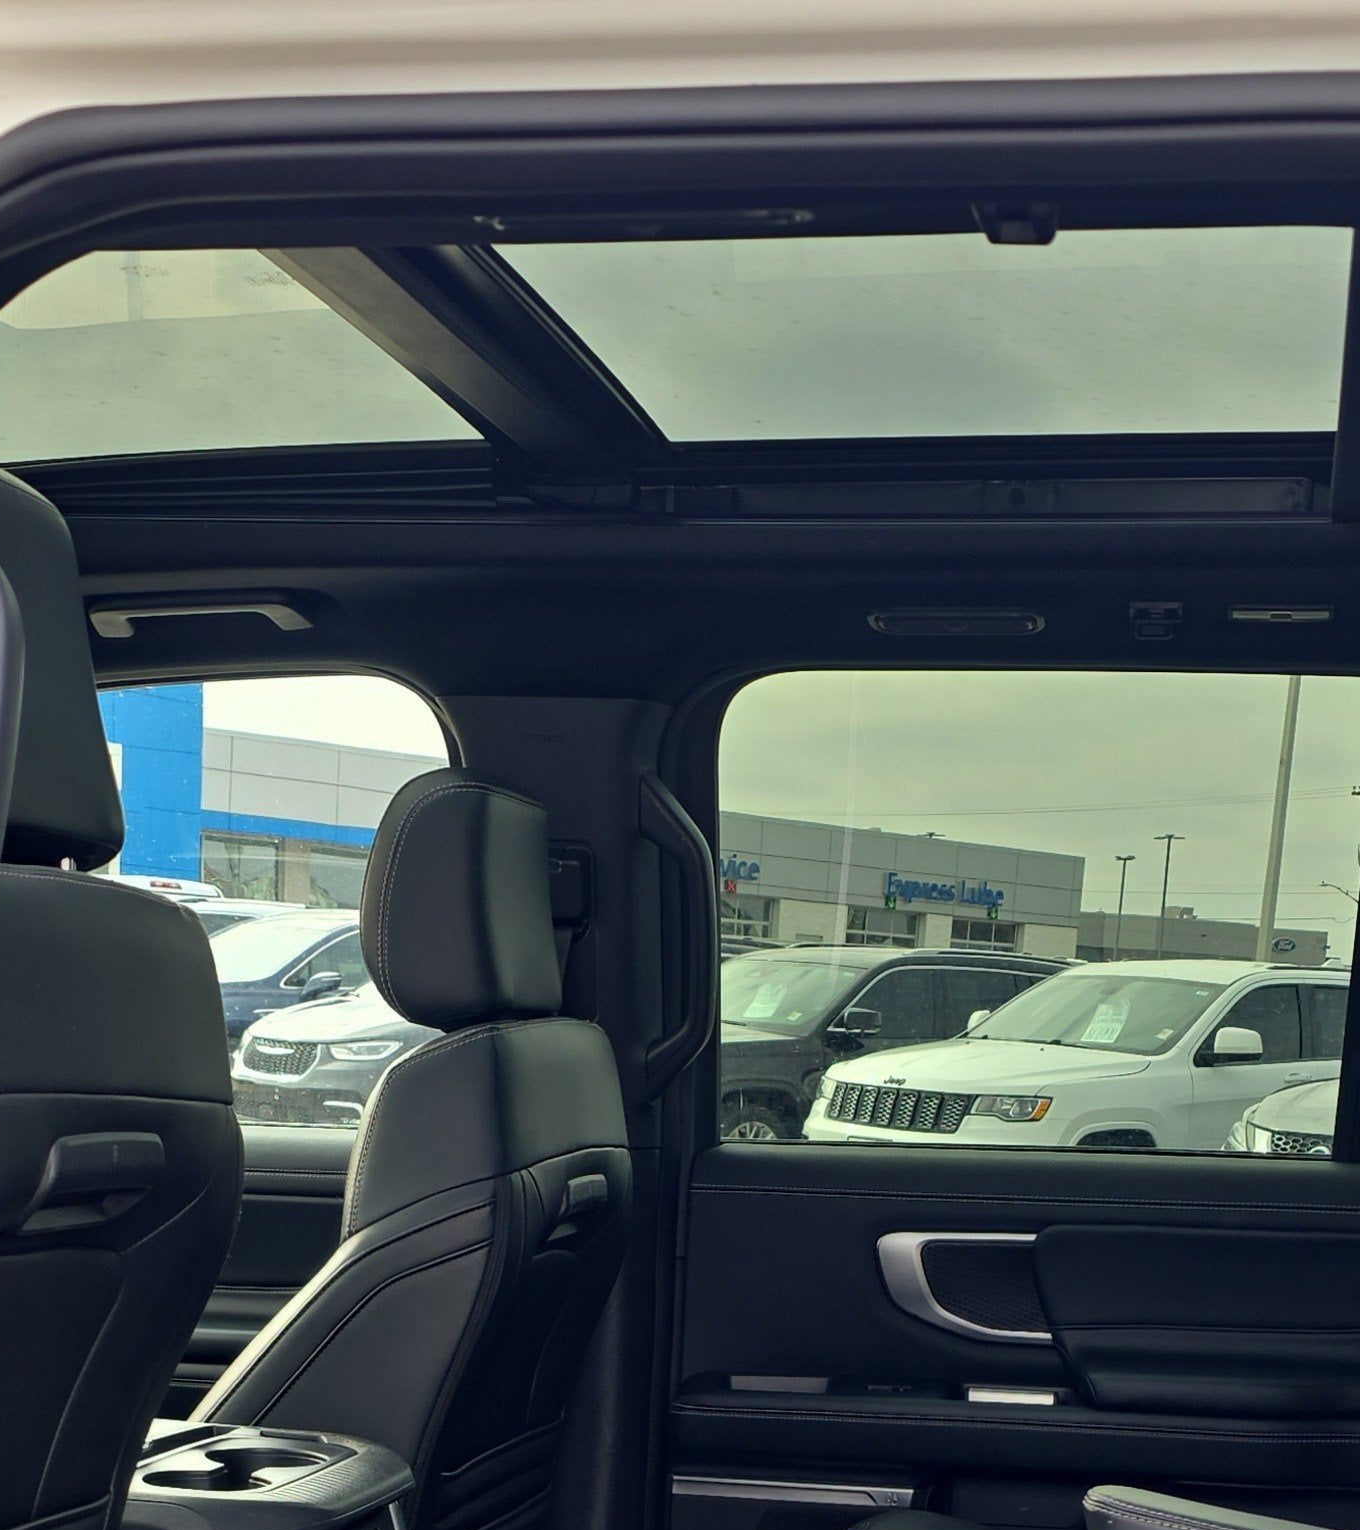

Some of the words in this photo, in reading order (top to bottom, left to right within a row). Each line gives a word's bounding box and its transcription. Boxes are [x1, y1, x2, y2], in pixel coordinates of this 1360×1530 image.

[886, 871, 956, 904] Express
[961, 879, 1004, 908] Lube
[1275, 940, 1294, 952] Ford
[883, 1075, 907, 1087] Jeep
